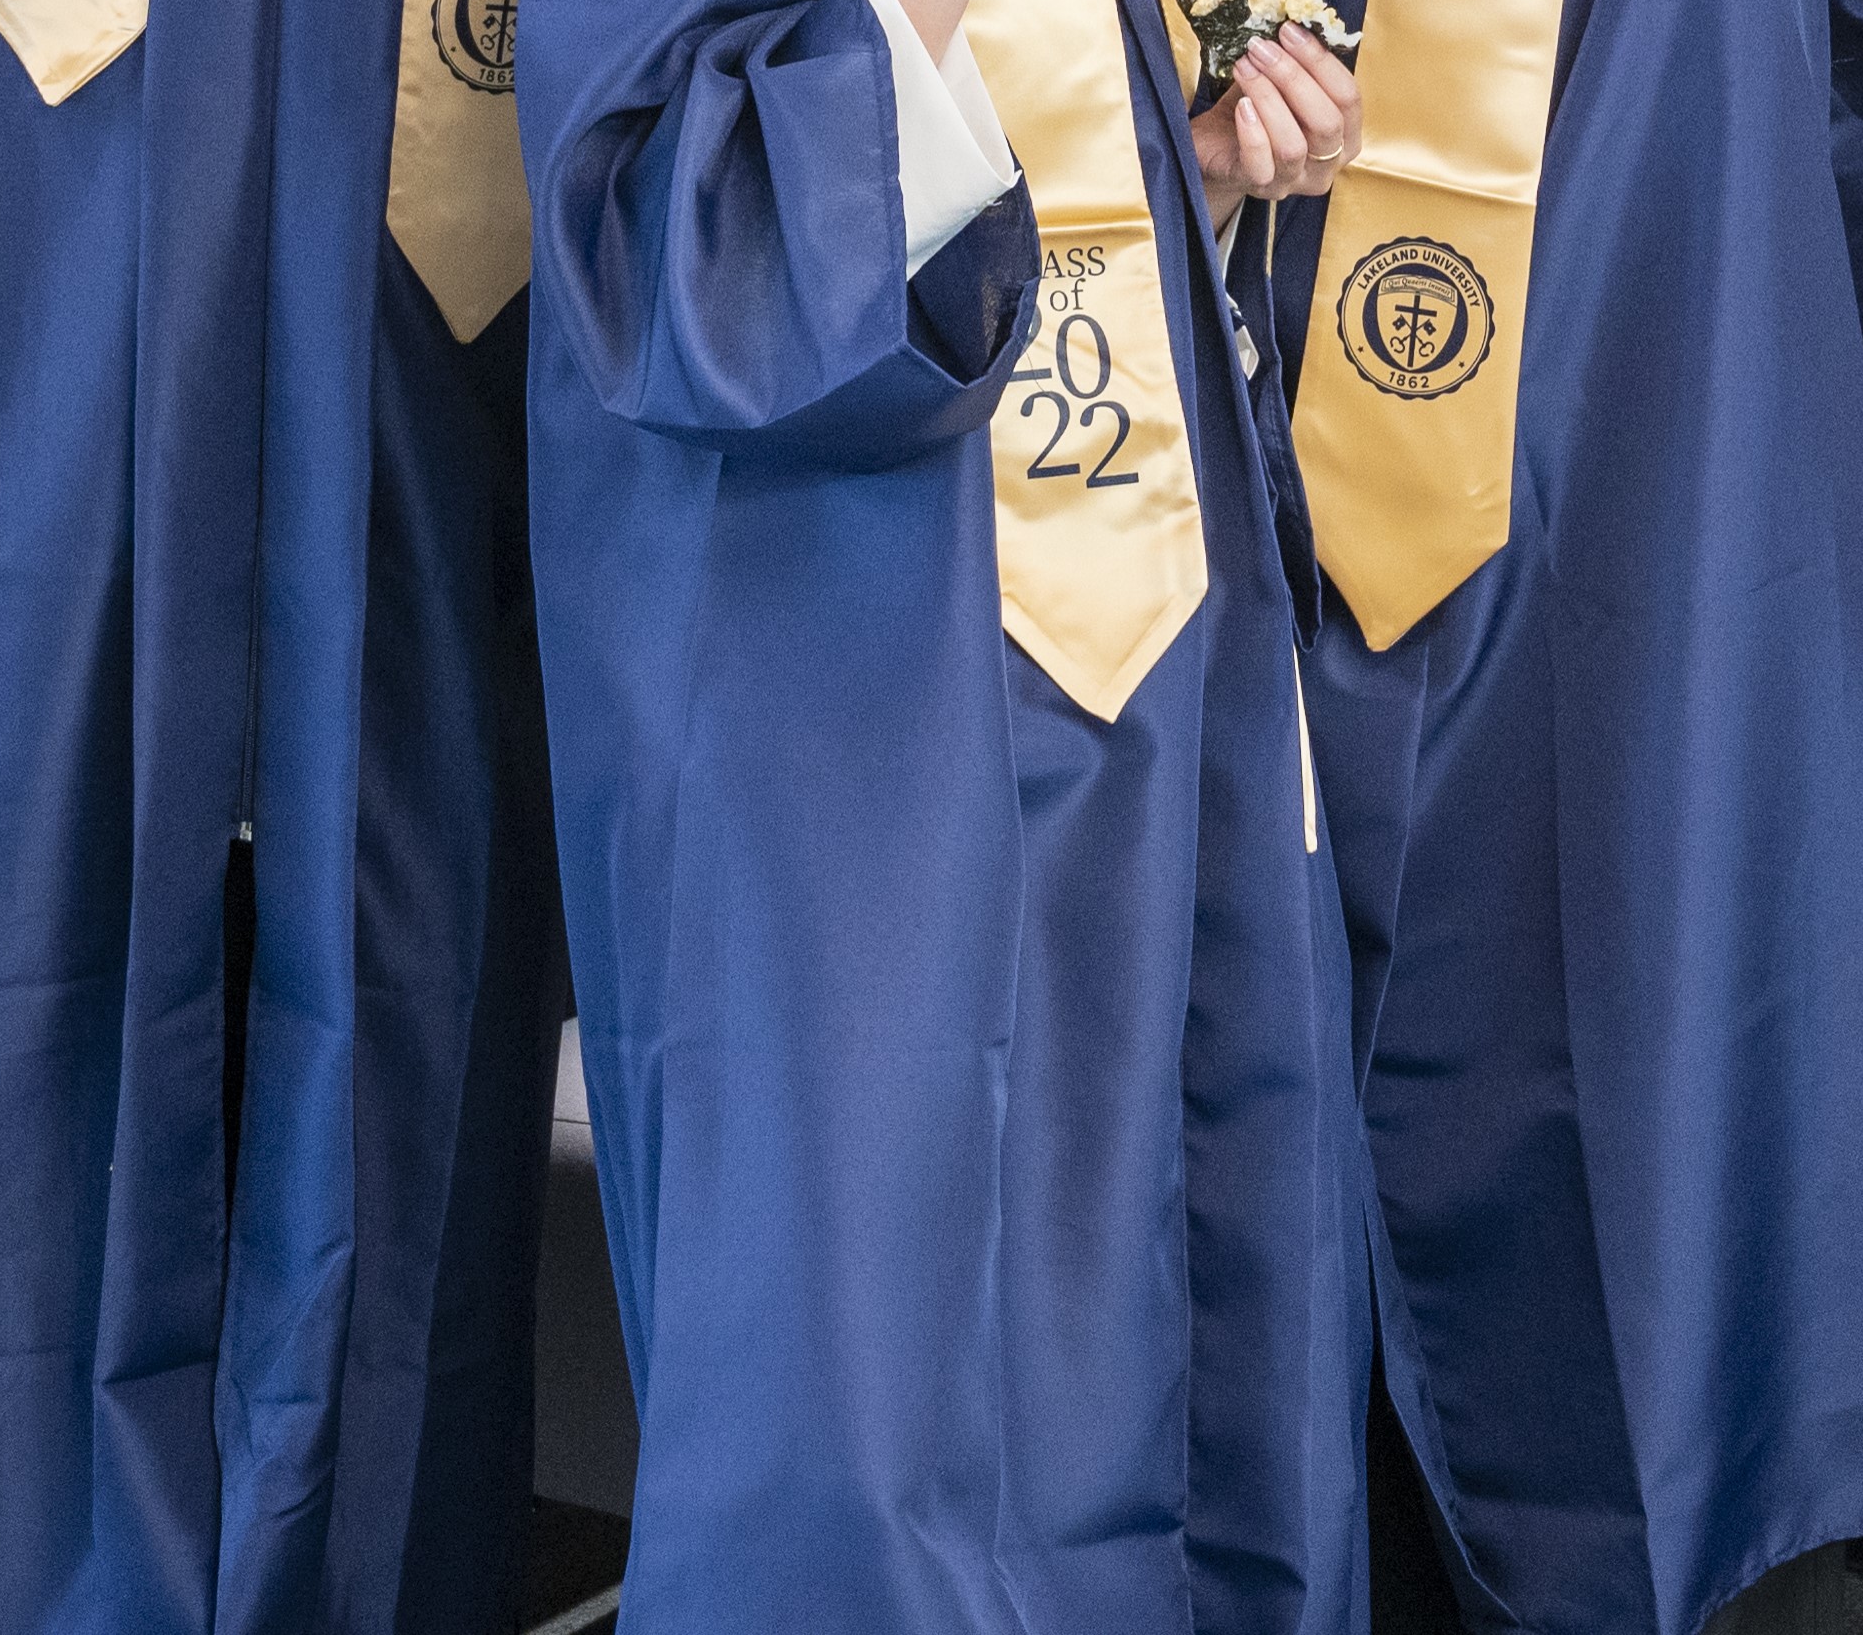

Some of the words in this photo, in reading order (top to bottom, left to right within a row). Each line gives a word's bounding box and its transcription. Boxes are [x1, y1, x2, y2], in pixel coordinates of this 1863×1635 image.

[478, 67, 516, 84] 1862
[1040, 245, 1106, 279] ASS
[1357, 248, 1419, 290] LAKELAND
[1422, 249, 1481, 308] UNIVERSITY
[1049, 278, 1087, 312] of
[1388, 371, 1430, 389] 1862
[1020, 390, 1140, 489] 22
